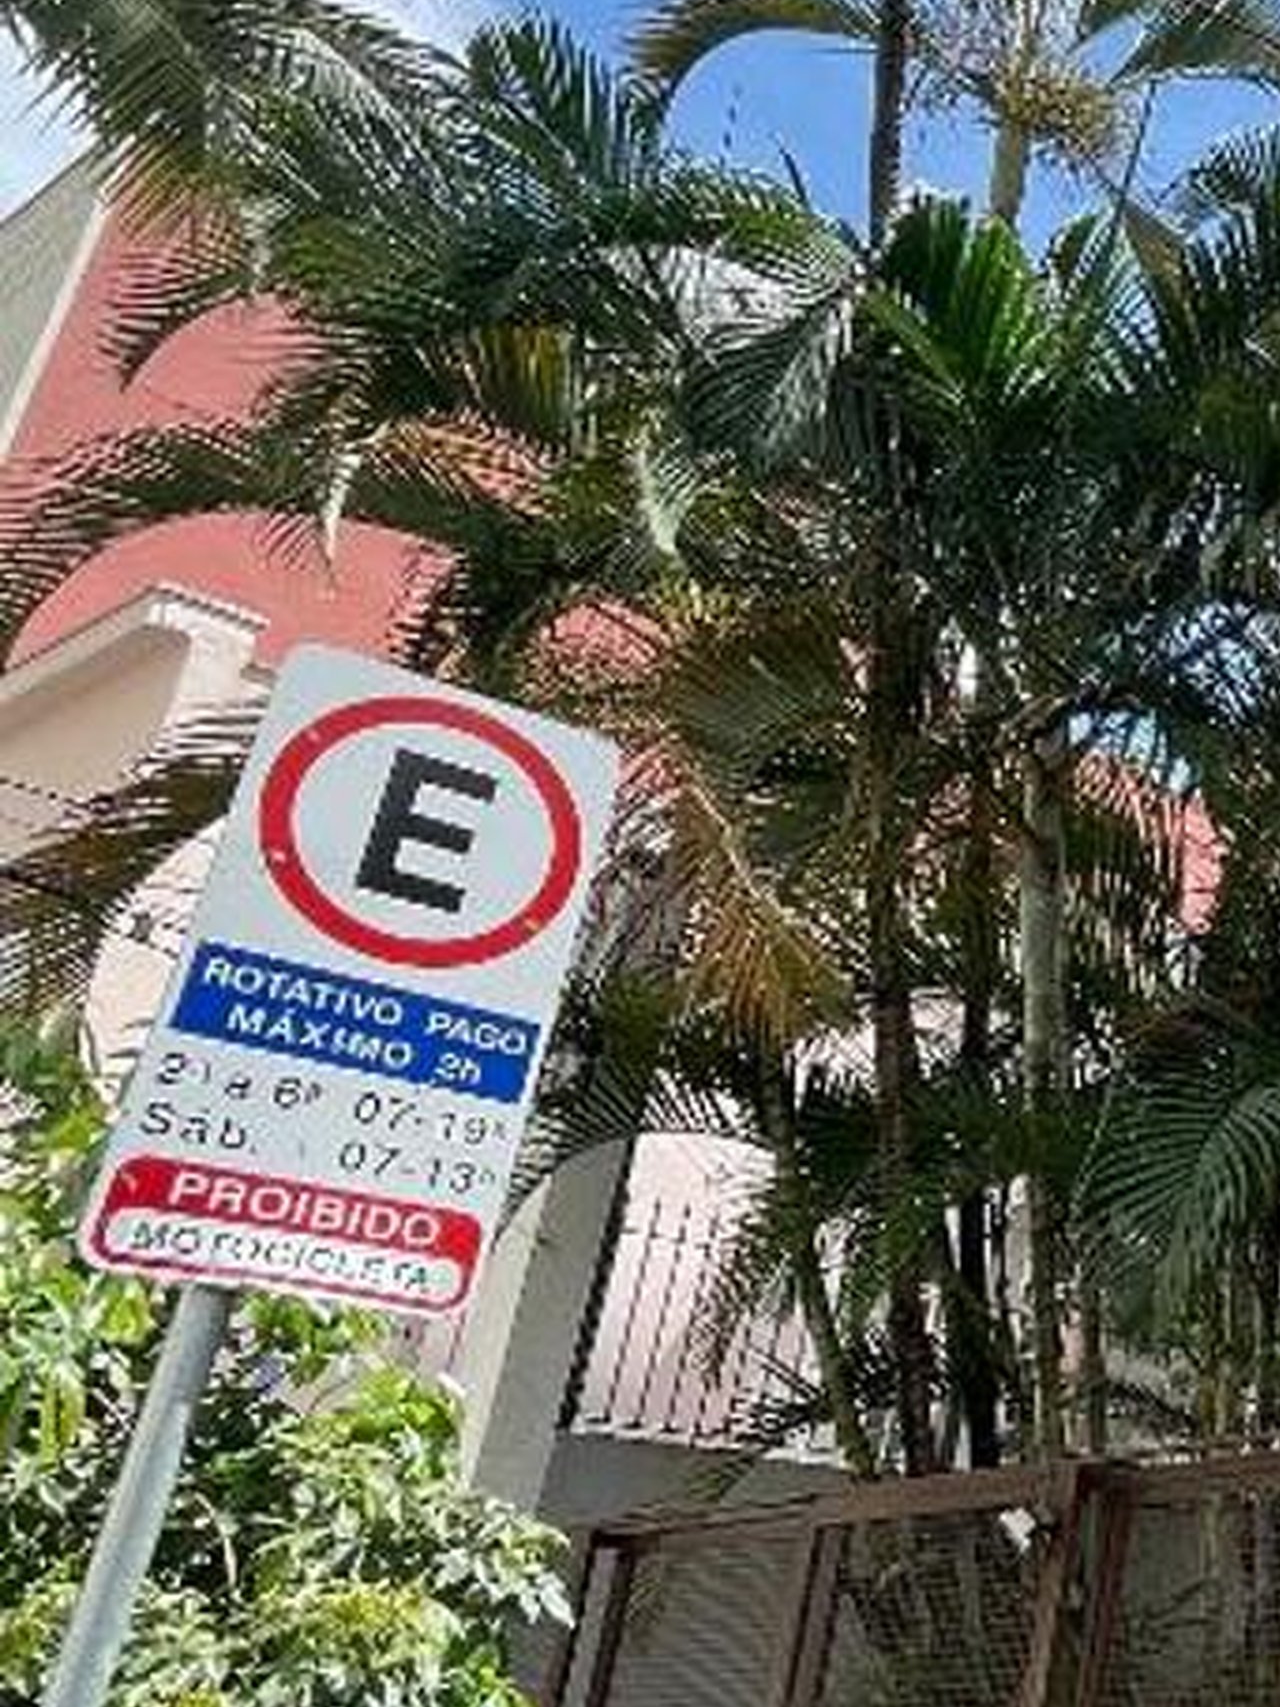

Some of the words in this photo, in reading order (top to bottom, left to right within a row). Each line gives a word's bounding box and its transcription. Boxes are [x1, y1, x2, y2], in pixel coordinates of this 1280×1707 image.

[356, 747, 497, 914] E
[203, 956, 403, 1027] ROTATIVO
[424, 1013, 526, 1056] PAGO
[226, 1002, 413, 1069] MÁXIMO
[434, 1052, 482, 1084] 2h
[168, 1172, 439, 1245] PROIBIDO
[128, 1221, 429, 1292] MOTOCICLETA
